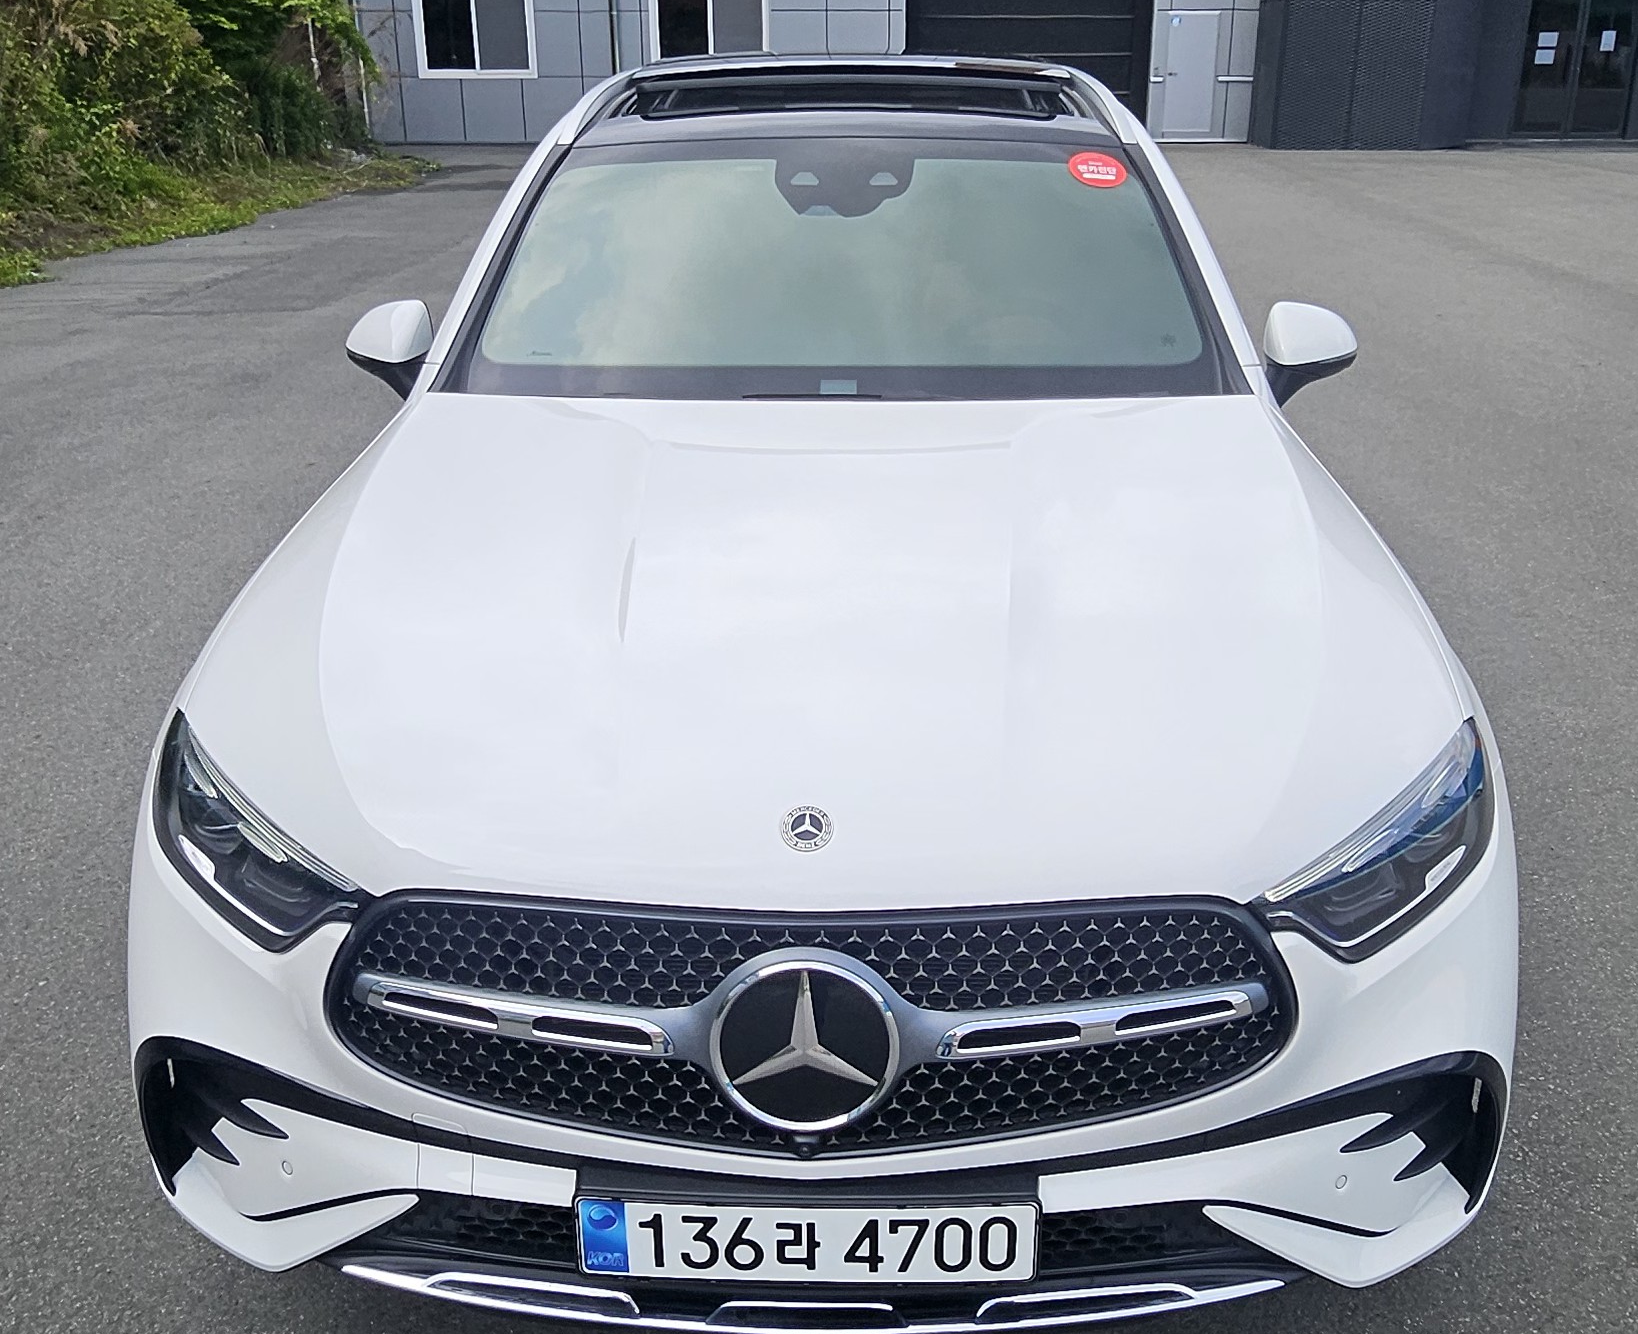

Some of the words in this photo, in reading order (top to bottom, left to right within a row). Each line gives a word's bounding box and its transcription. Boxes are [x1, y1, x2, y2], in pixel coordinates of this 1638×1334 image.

[587, 1251, 624, 1266] KOR
[638, 1213, 821, 1271] 136라
[843, 1216, 1018, 1273] 4700
